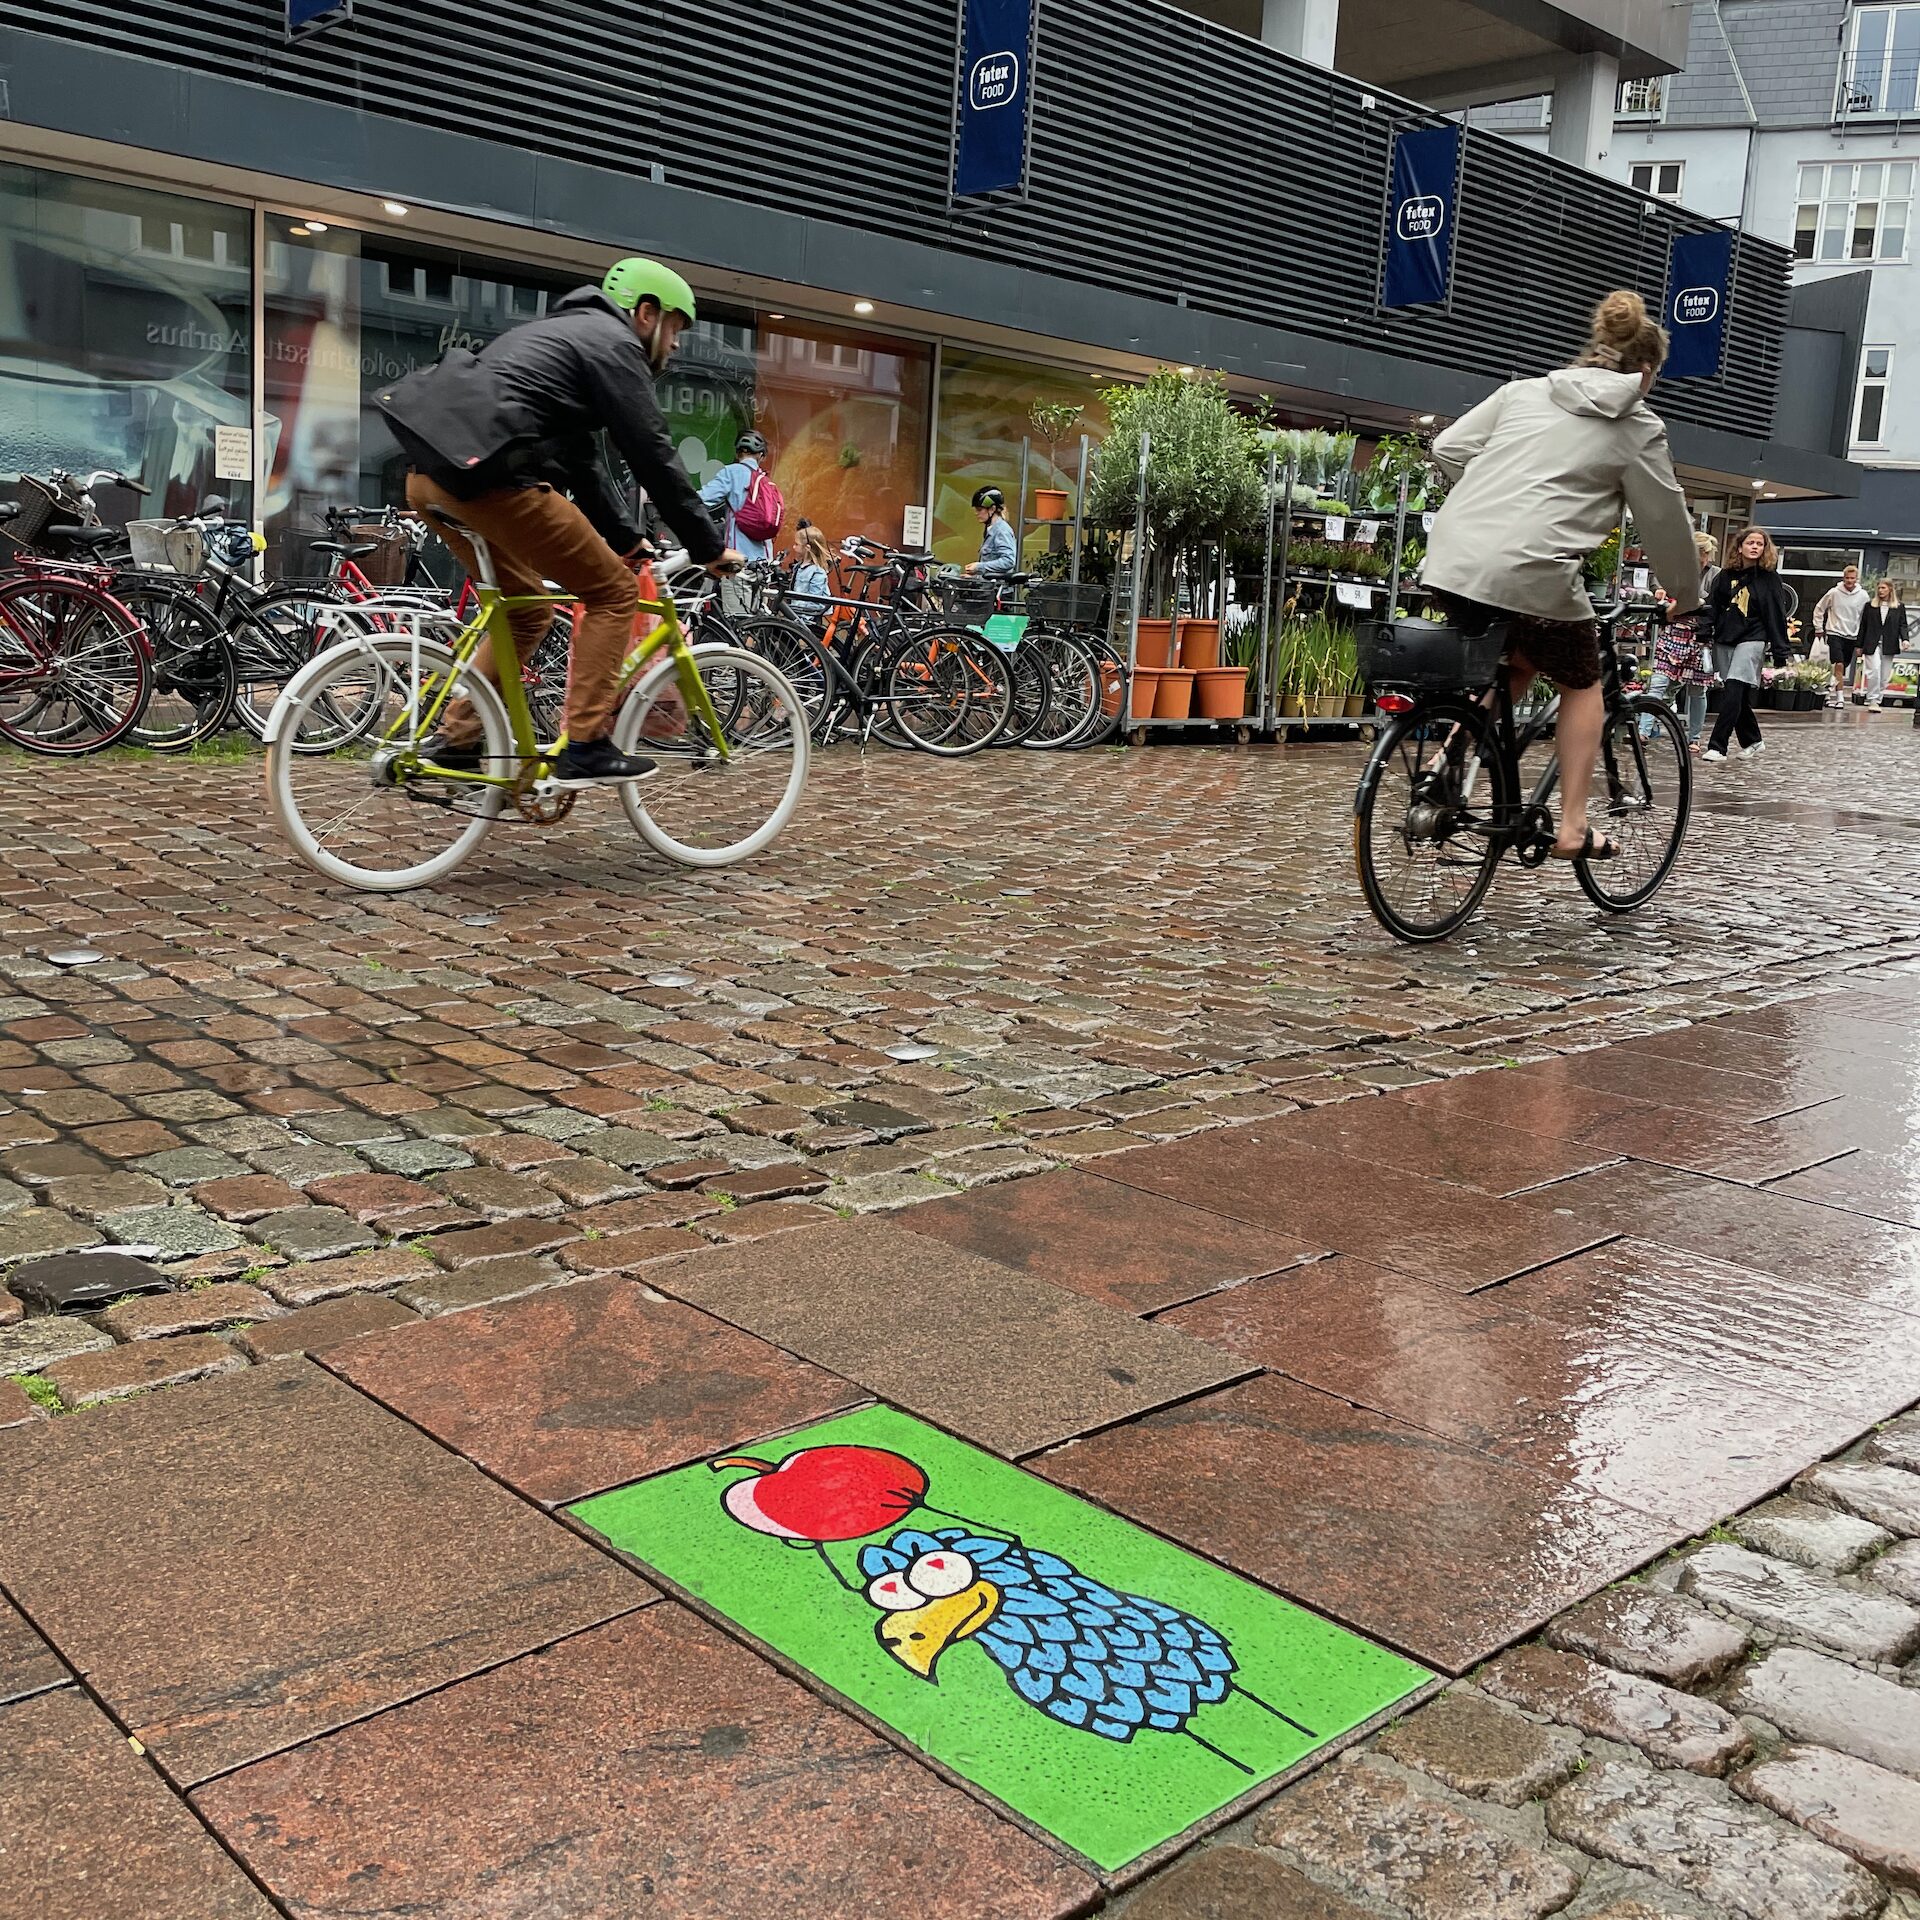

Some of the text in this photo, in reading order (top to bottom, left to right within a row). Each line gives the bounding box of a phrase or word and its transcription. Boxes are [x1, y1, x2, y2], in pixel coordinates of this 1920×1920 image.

[981, 83, 1005, 100] FOOD
[1408, 220, 1432, 232] FOOD
[1685, 307, 1707, 318] FOOD
